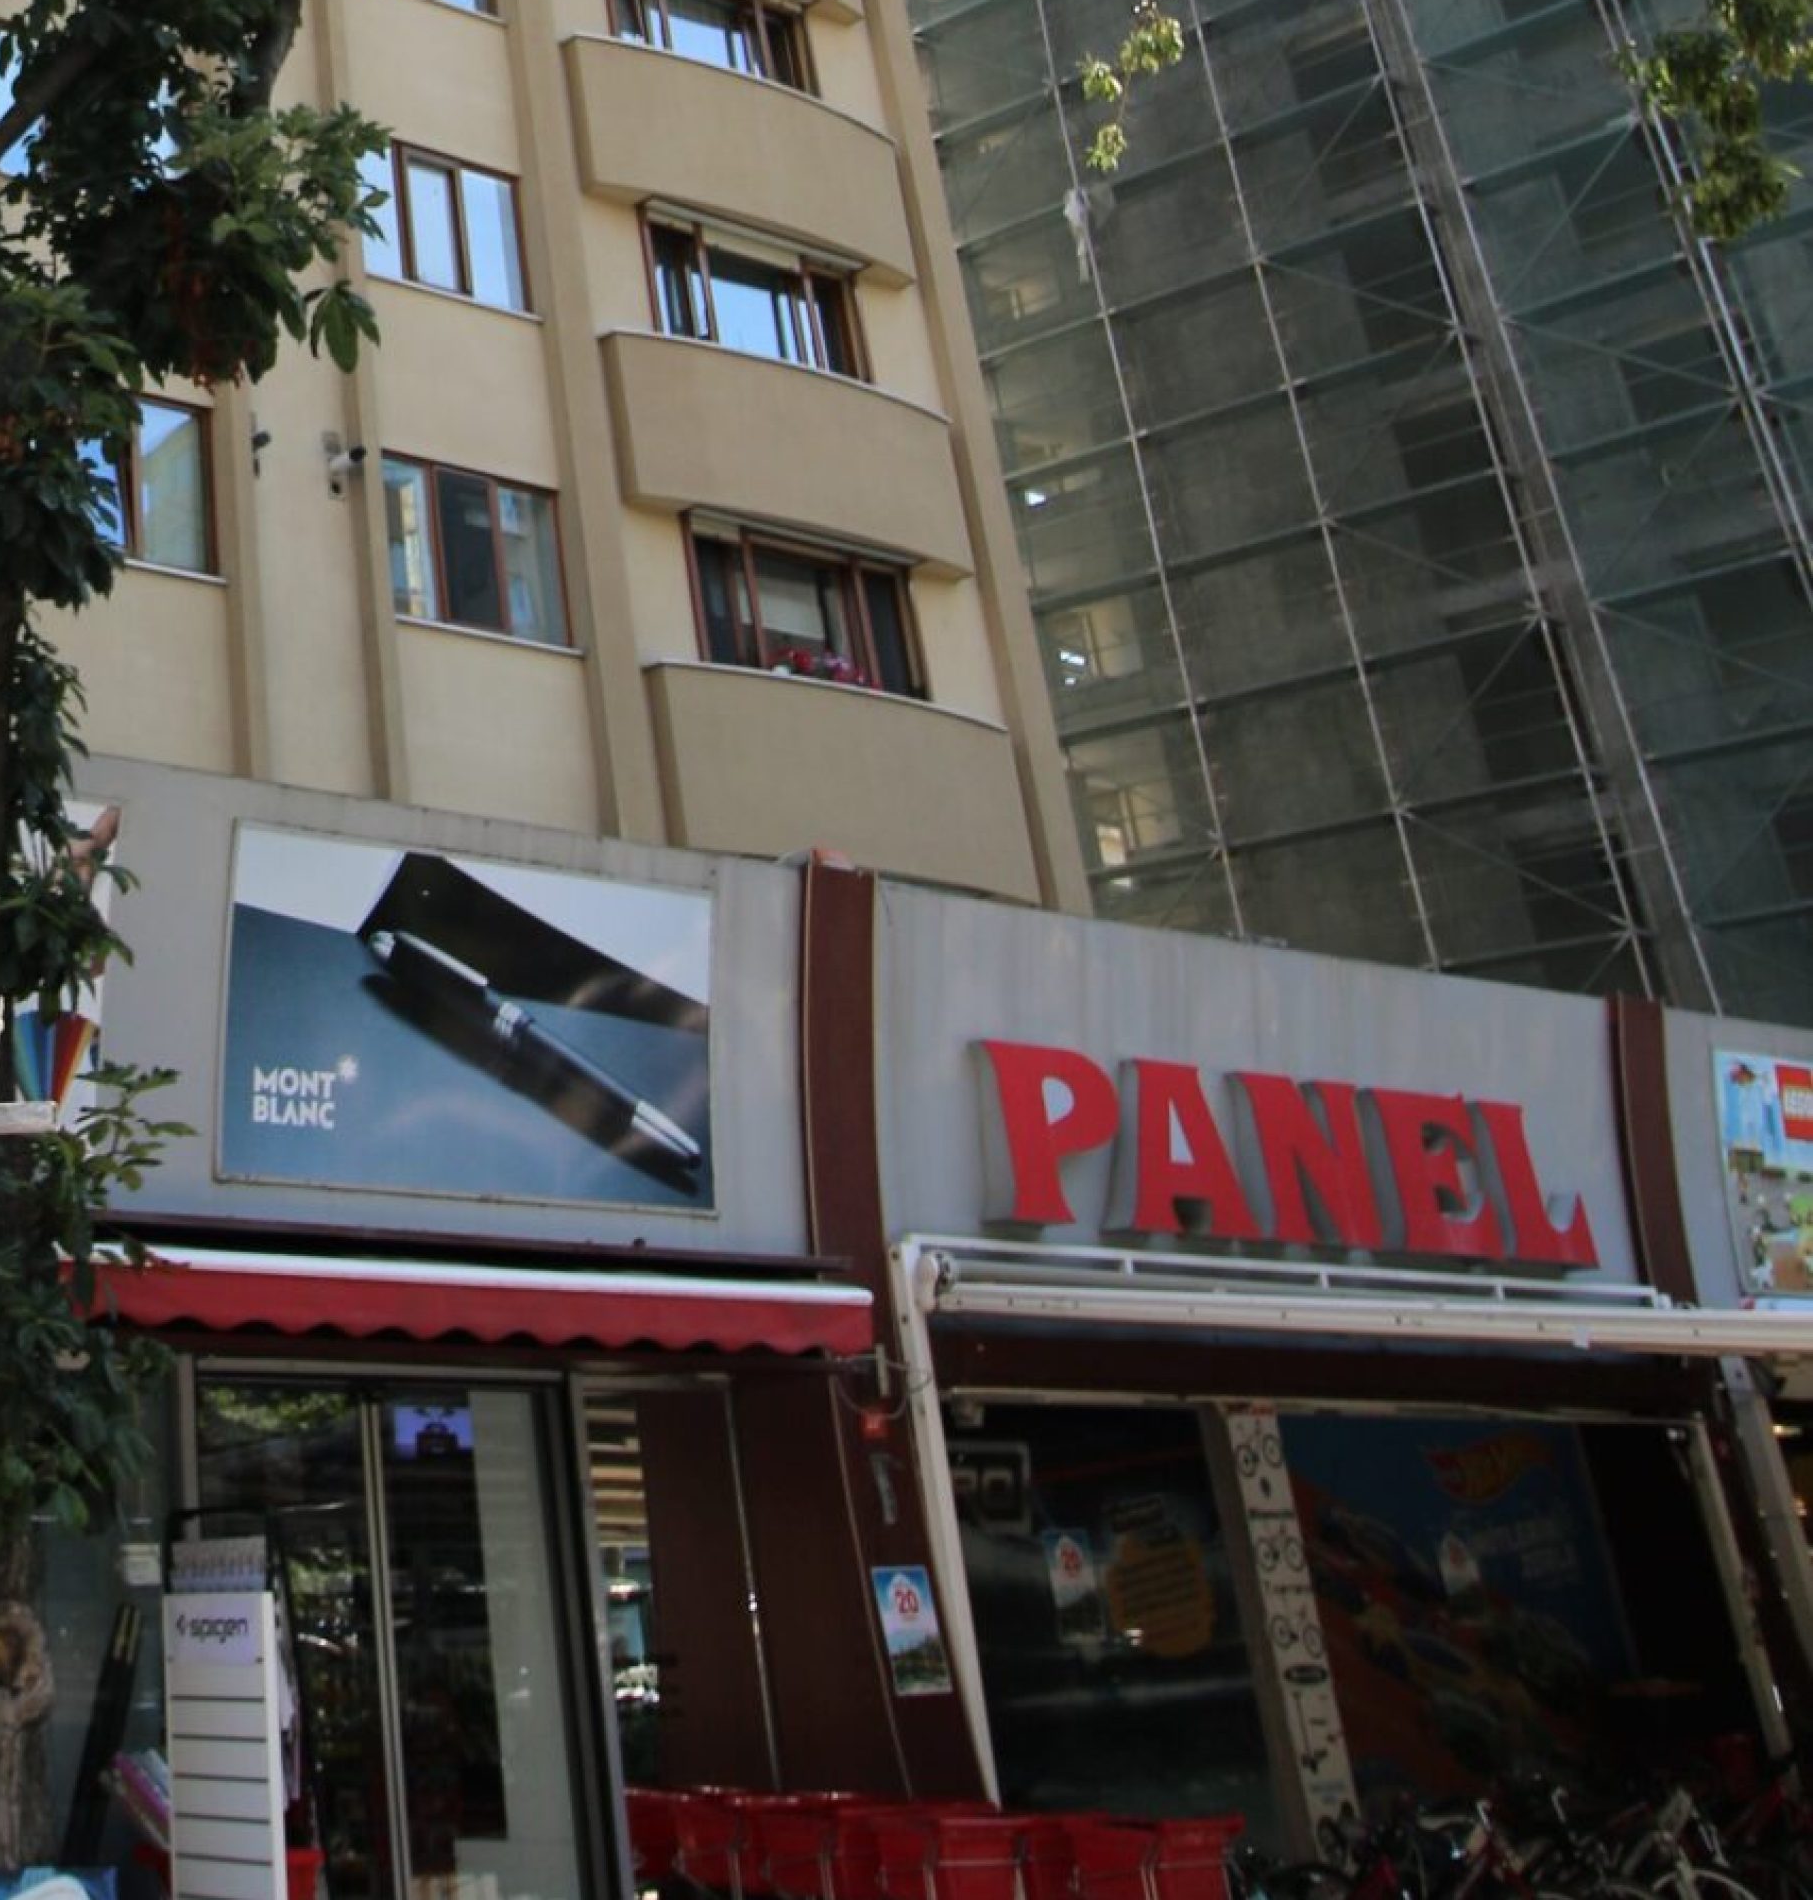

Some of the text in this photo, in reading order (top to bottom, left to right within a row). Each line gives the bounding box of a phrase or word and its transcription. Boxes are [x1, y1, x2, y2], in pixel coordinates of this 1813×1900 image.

[252, 1066, 336, 1099] MONT
[252, 1094, 336, 1130] BLANC
[976, 1038, 1600, 1269] PANEL
